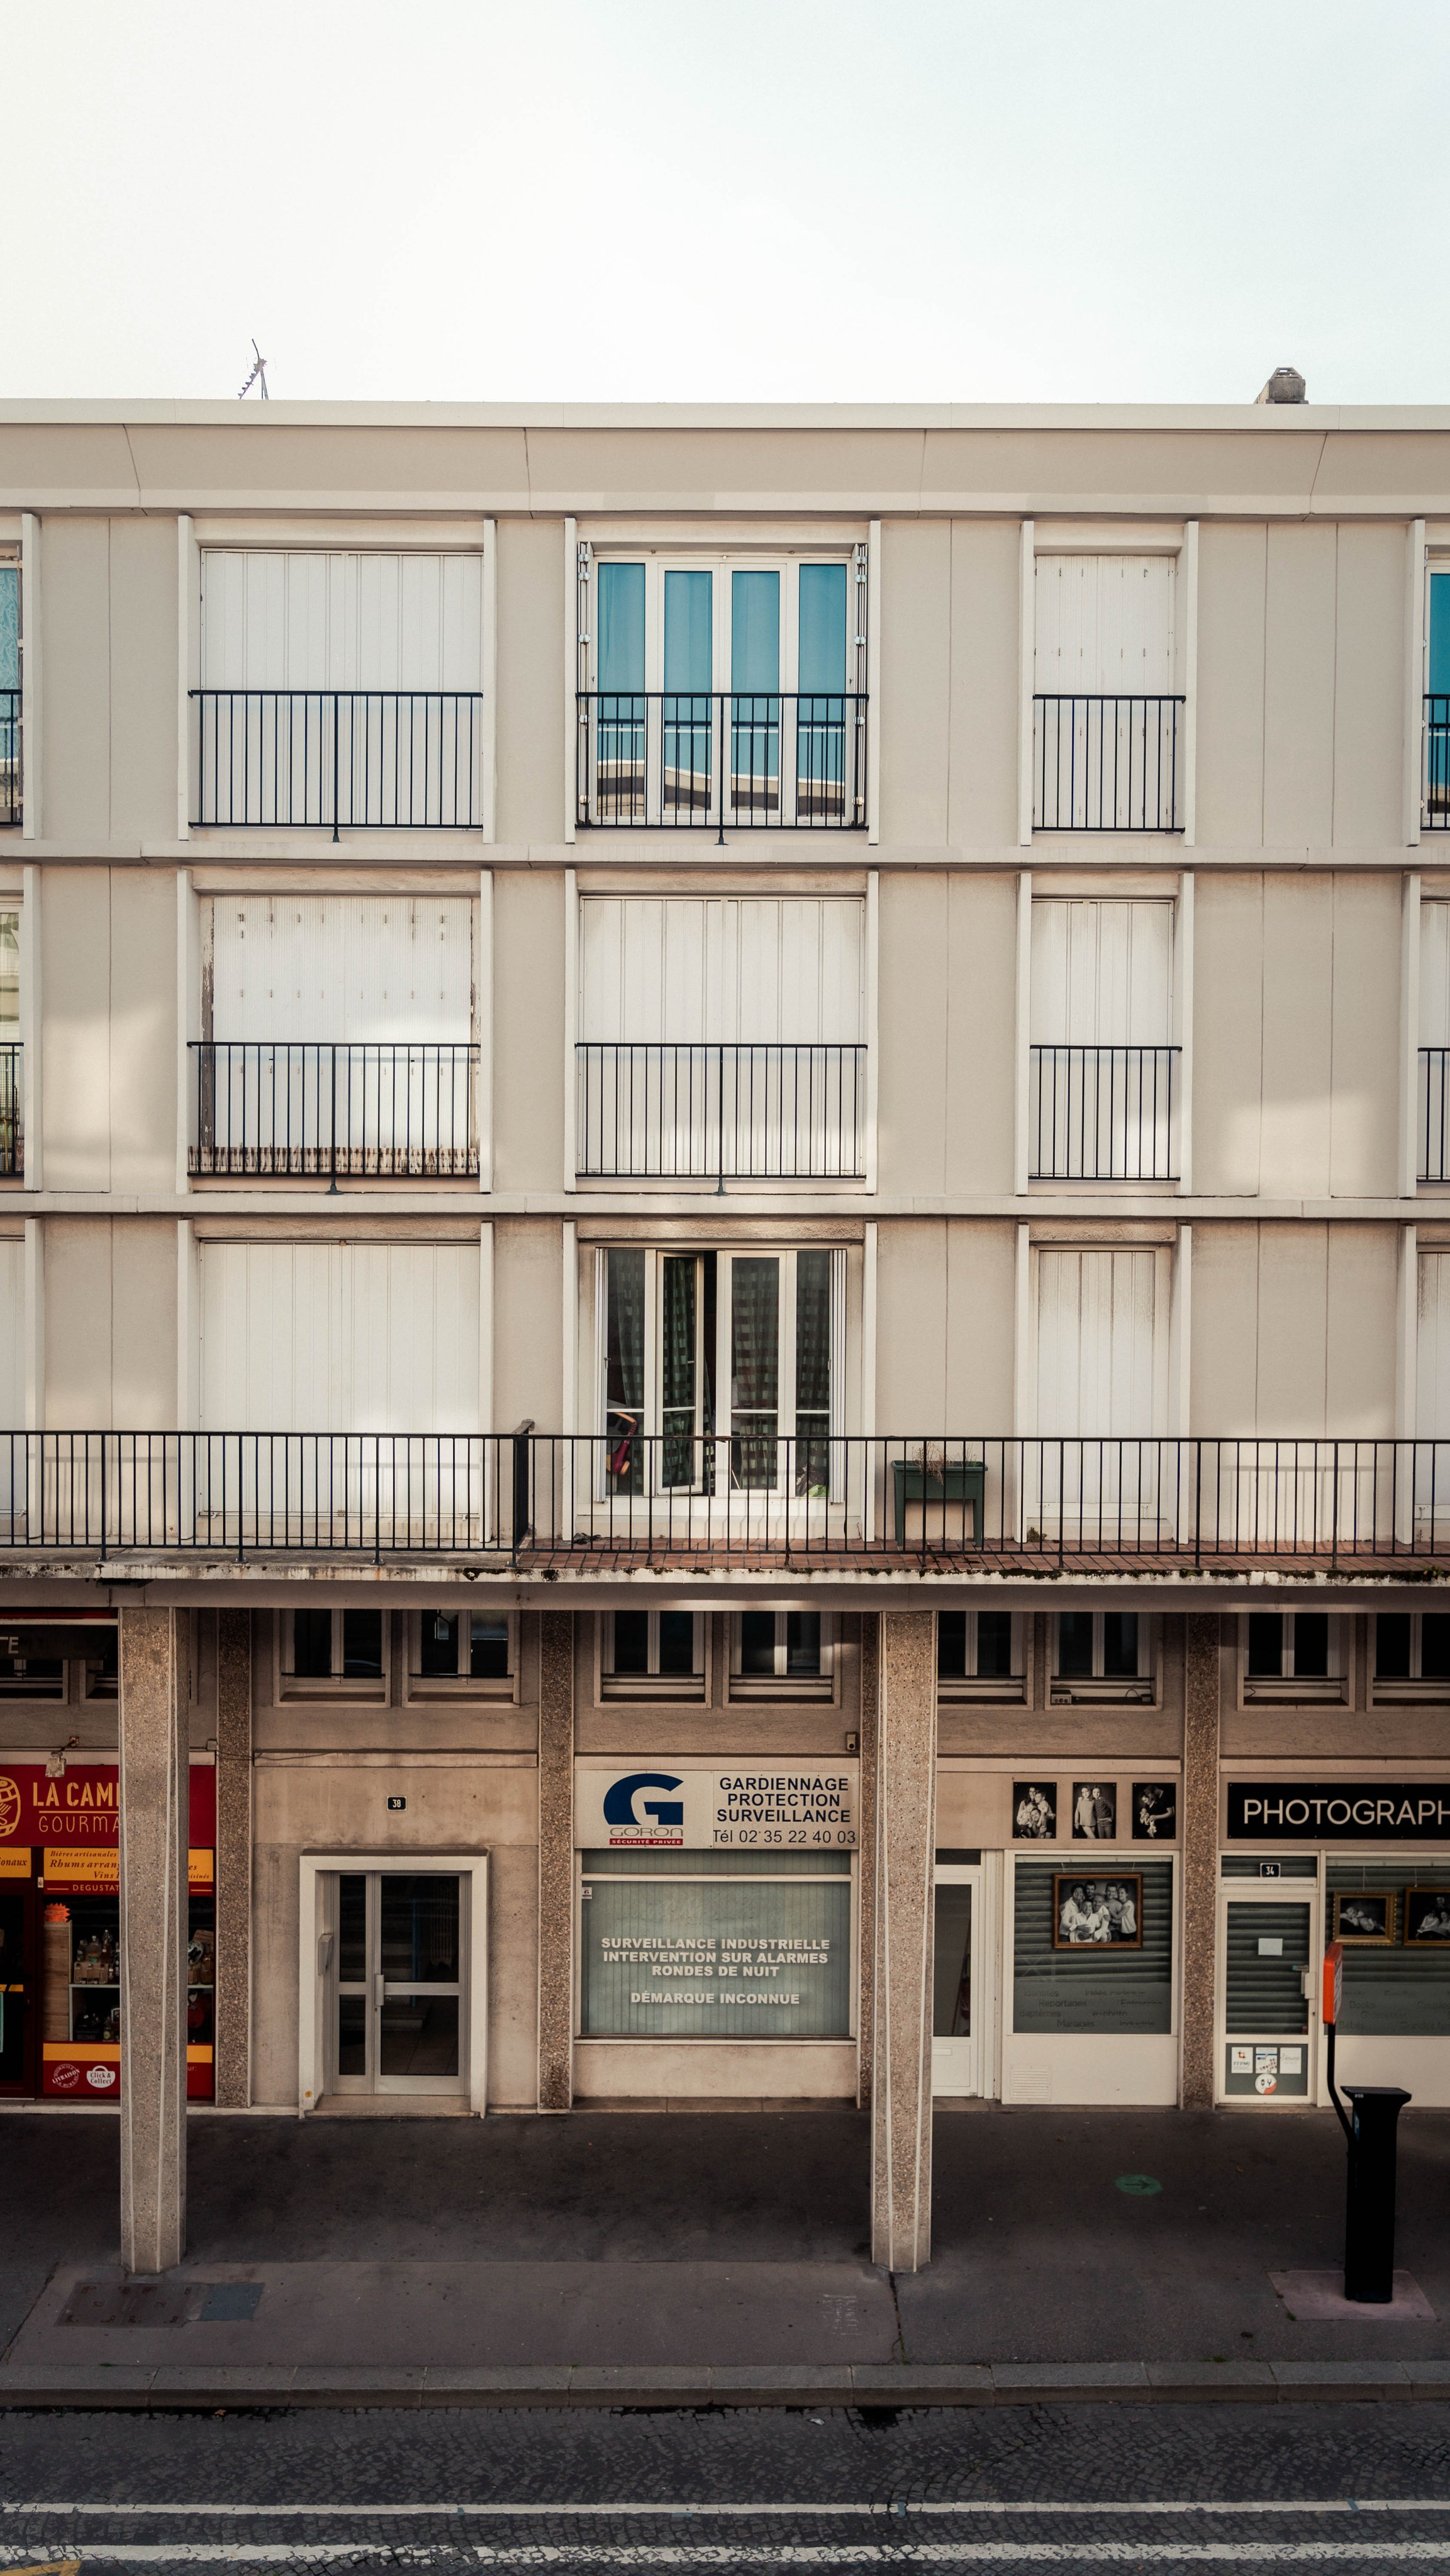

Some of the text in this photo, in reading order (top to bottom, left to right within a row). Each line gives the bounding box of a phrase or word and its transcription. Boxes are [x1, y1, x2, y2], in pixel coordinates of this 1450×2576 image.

[720, 1777, 849, 1791] GARDIENNAGE
[33, 1782, 119, 1807] LA CAM
[728, 1793, 840, 1807] PROTECTION
[393, 1799, 401, 1808] 38
[717, 1809, 850, 1823] SURVEILLANCE
[610, 1827, 684, 1837] GORON
[713, 1829, 856, 1843] Tél 02 35 22 40 03
[0, 1857, 28, 1867] onaux
[50, 1859, 86, 1868] Rhums
[94, 1870, 114, 1879] Vins
[1266, 1866, 1274, 1875] 34
[601, 1938, 830, 1950] SURVEILLANCE INDUSTRIELLE
[603, 1951, 828, 1963] INTERVENTION SUR ALARMES
[652, 1965, 779, 1977] RONDES DE NUIT
[631, 1990, 800, 2004] DÉMARQUE INCONNUE
[52, 2068, 80, 2084] LIVRAISON
